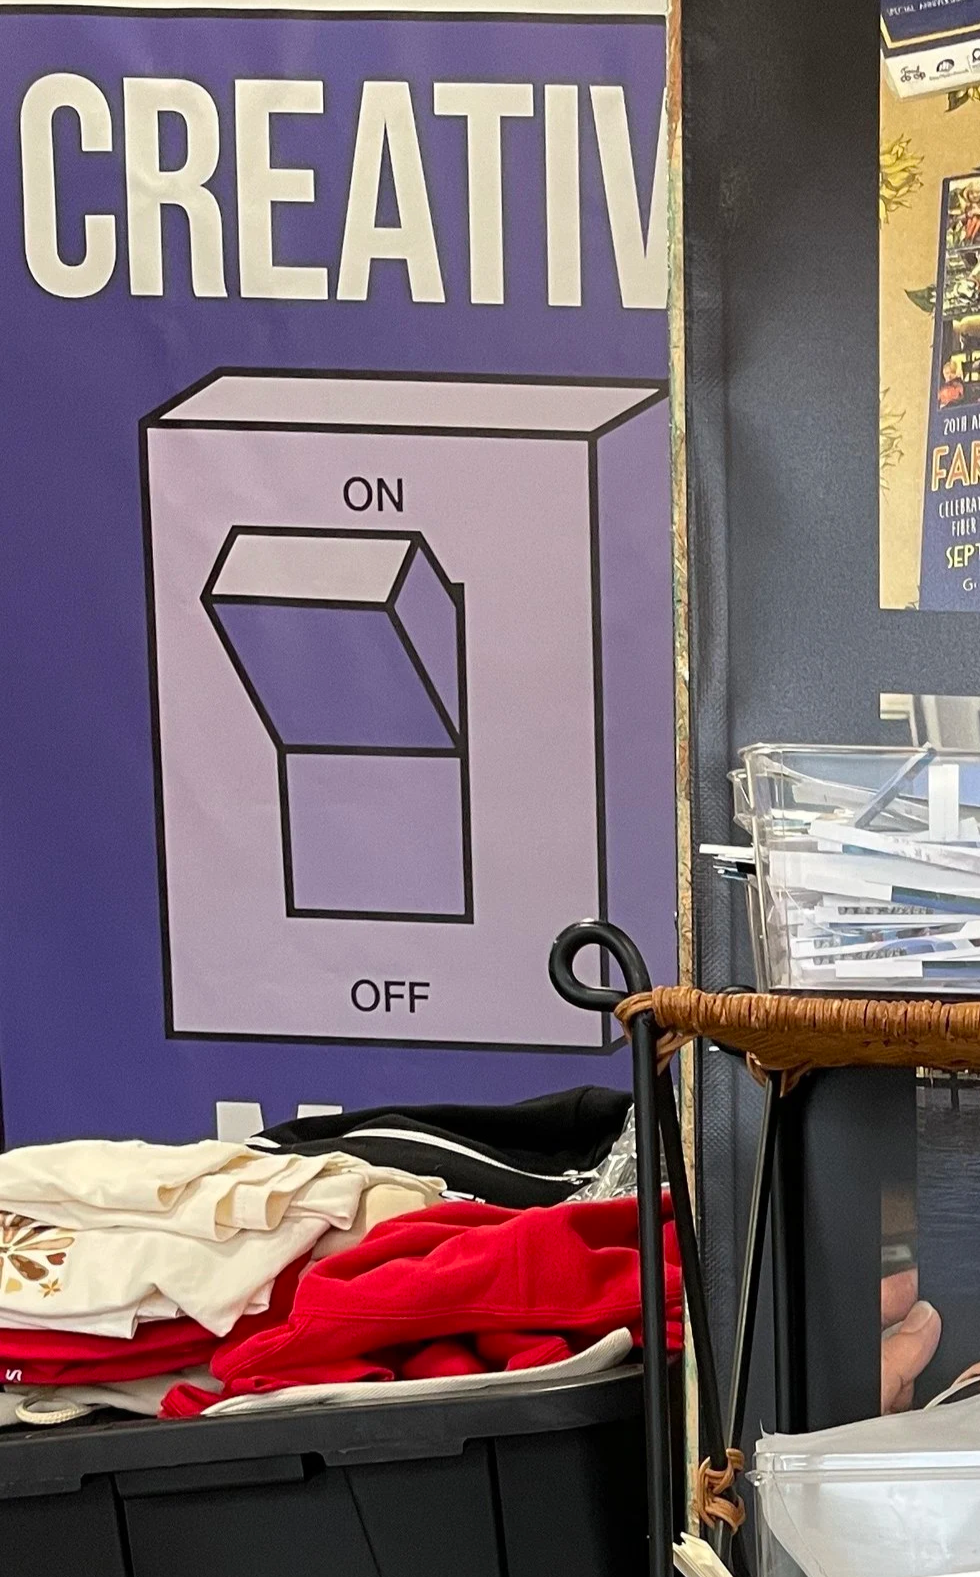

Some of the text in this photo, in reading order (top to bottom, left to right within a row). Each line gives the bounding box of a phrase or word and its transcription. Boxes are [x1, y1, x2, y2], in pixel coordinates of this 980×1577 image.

[343, 477, 404, 513] ON
[951, 516, 977, 537] FIBER
[350, 978, 431, 1014] OFF
